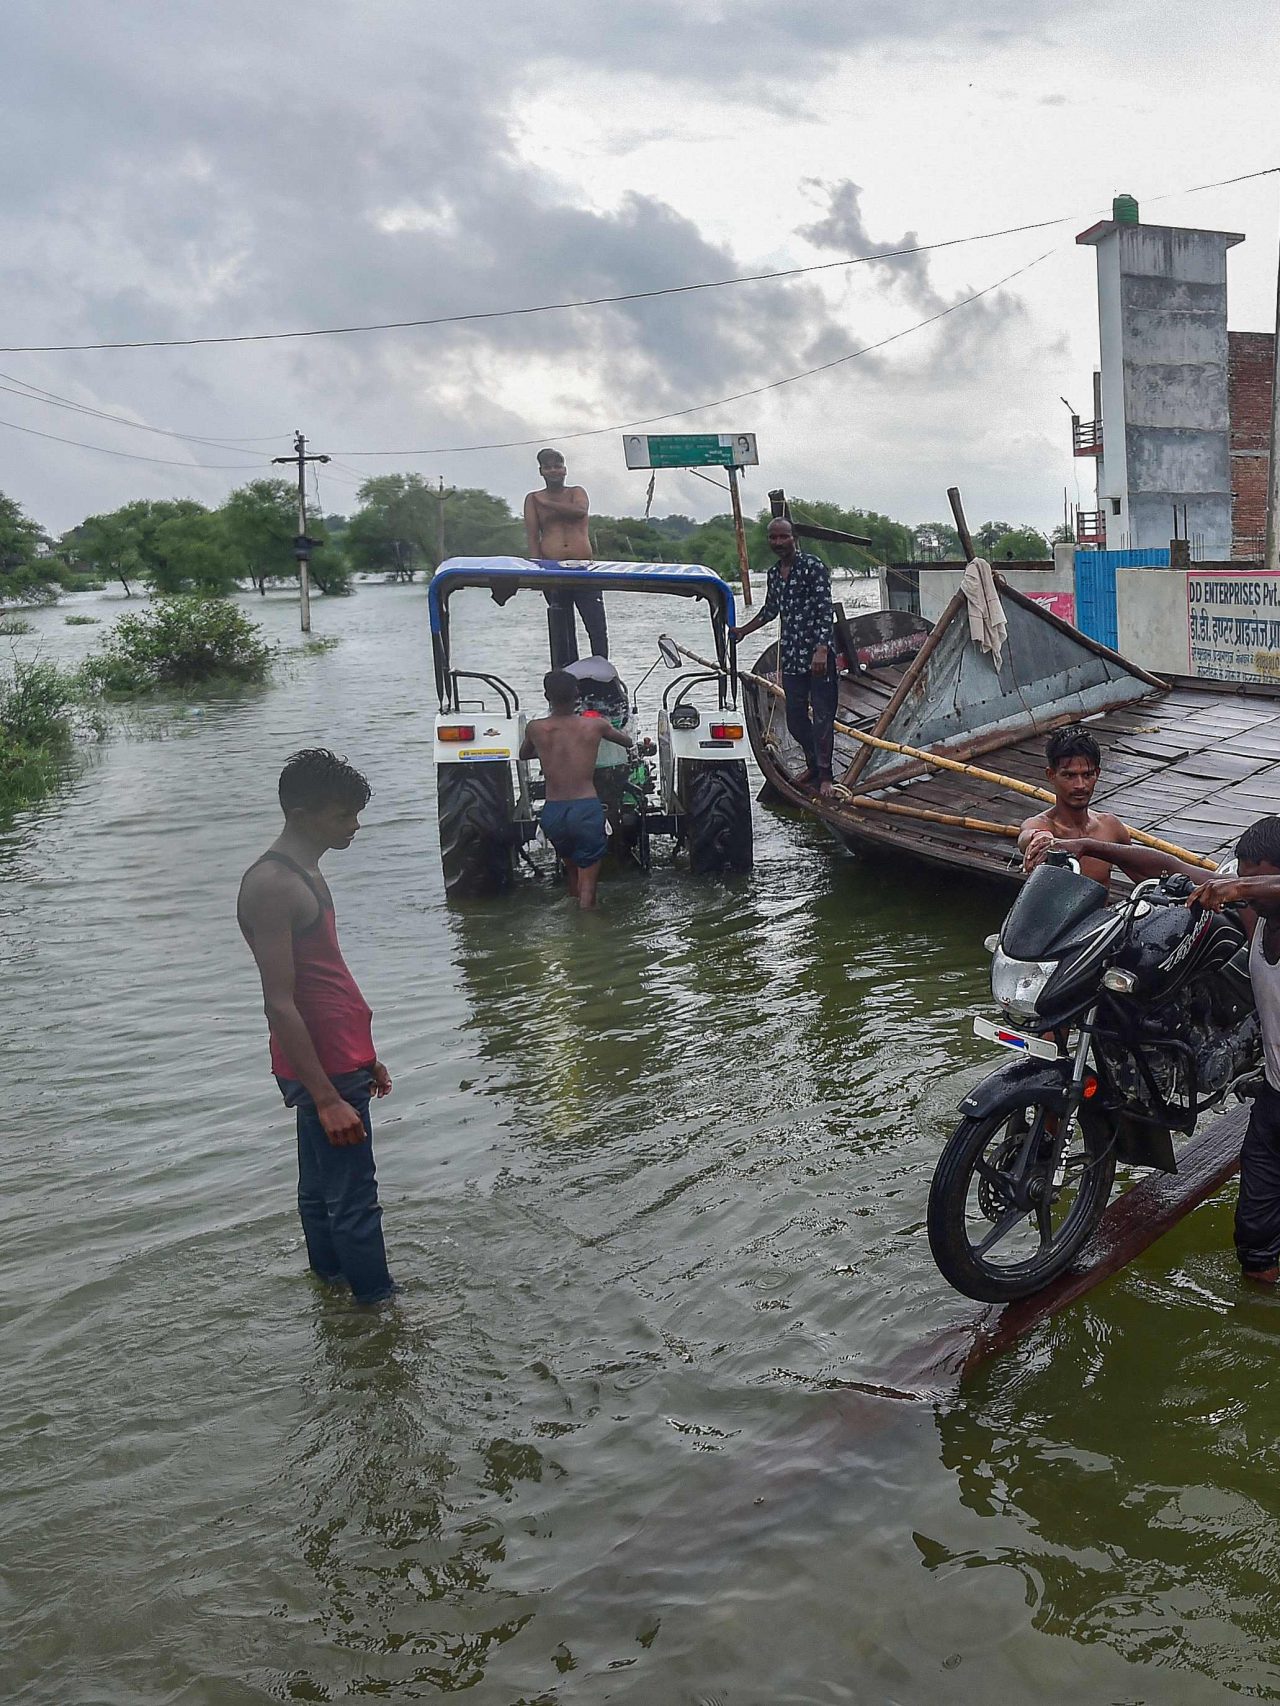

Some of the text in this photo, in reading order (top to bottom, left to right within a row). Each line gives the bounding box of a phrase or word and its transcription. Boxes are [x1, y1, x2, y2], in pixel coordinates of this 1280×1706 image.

[1190, 582, 1202, 602] DD
[1204, 582, 1261, 605] ENTERPRISES
[1263, 582, 1280, 606] Pvt.
